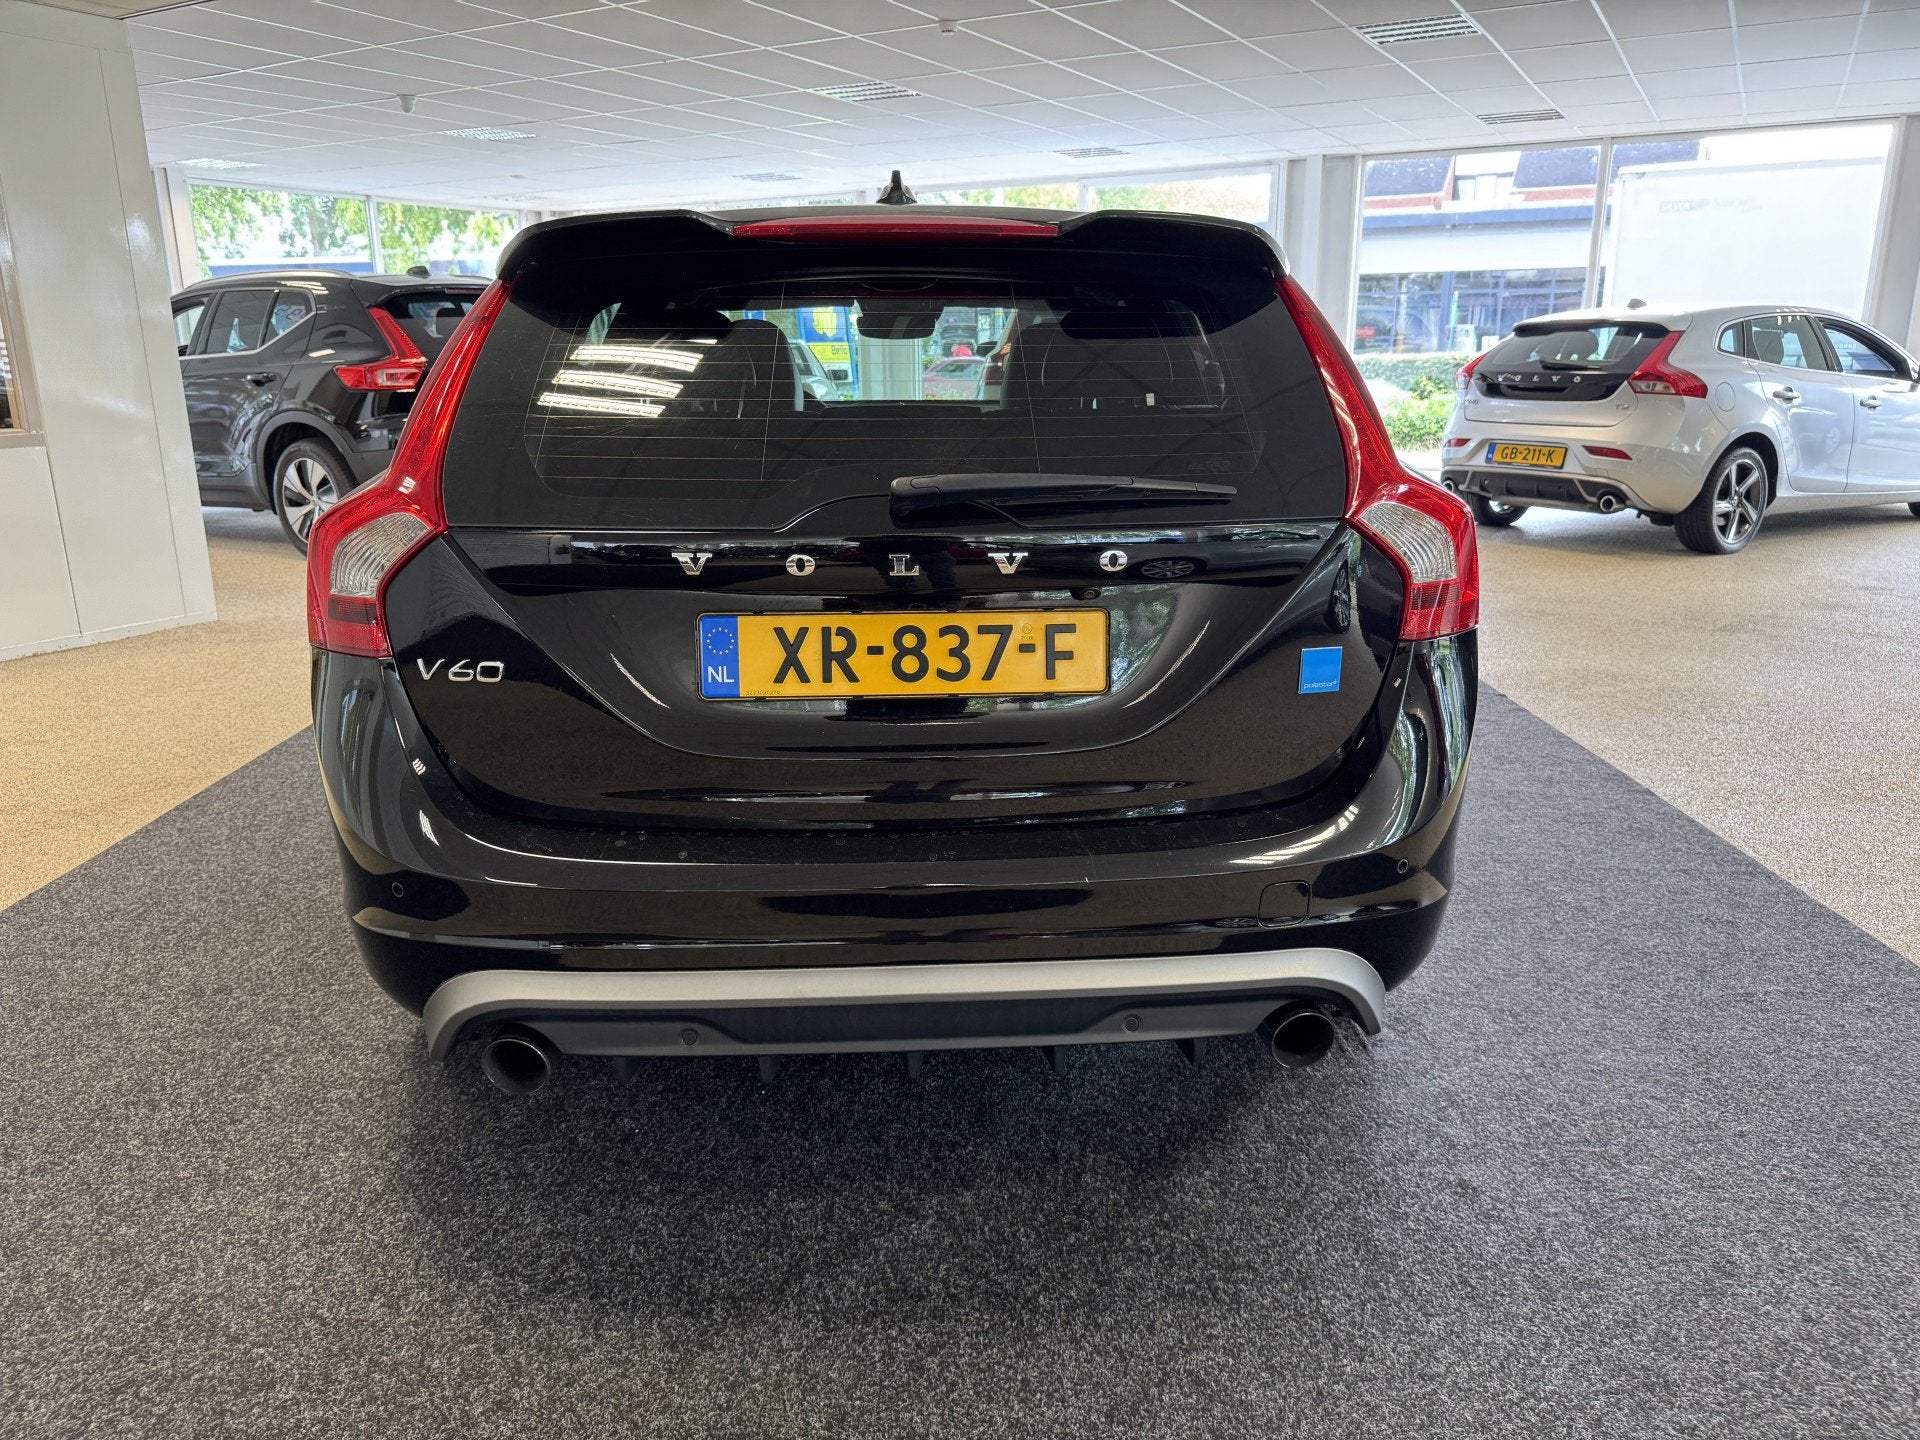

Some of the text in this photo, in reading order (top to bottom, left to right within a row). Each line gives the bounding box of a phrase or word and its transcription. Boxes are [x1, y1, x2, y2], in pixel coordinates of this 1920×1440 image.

[1501, 446, 1555, 463] GB-211-K
[671, 549, 1128, 577] VOLVO
[772, 623, 1077, 684] XR-837-F
[416, 658, 504, 683] V60
[707, 665, 735, 683] NL
